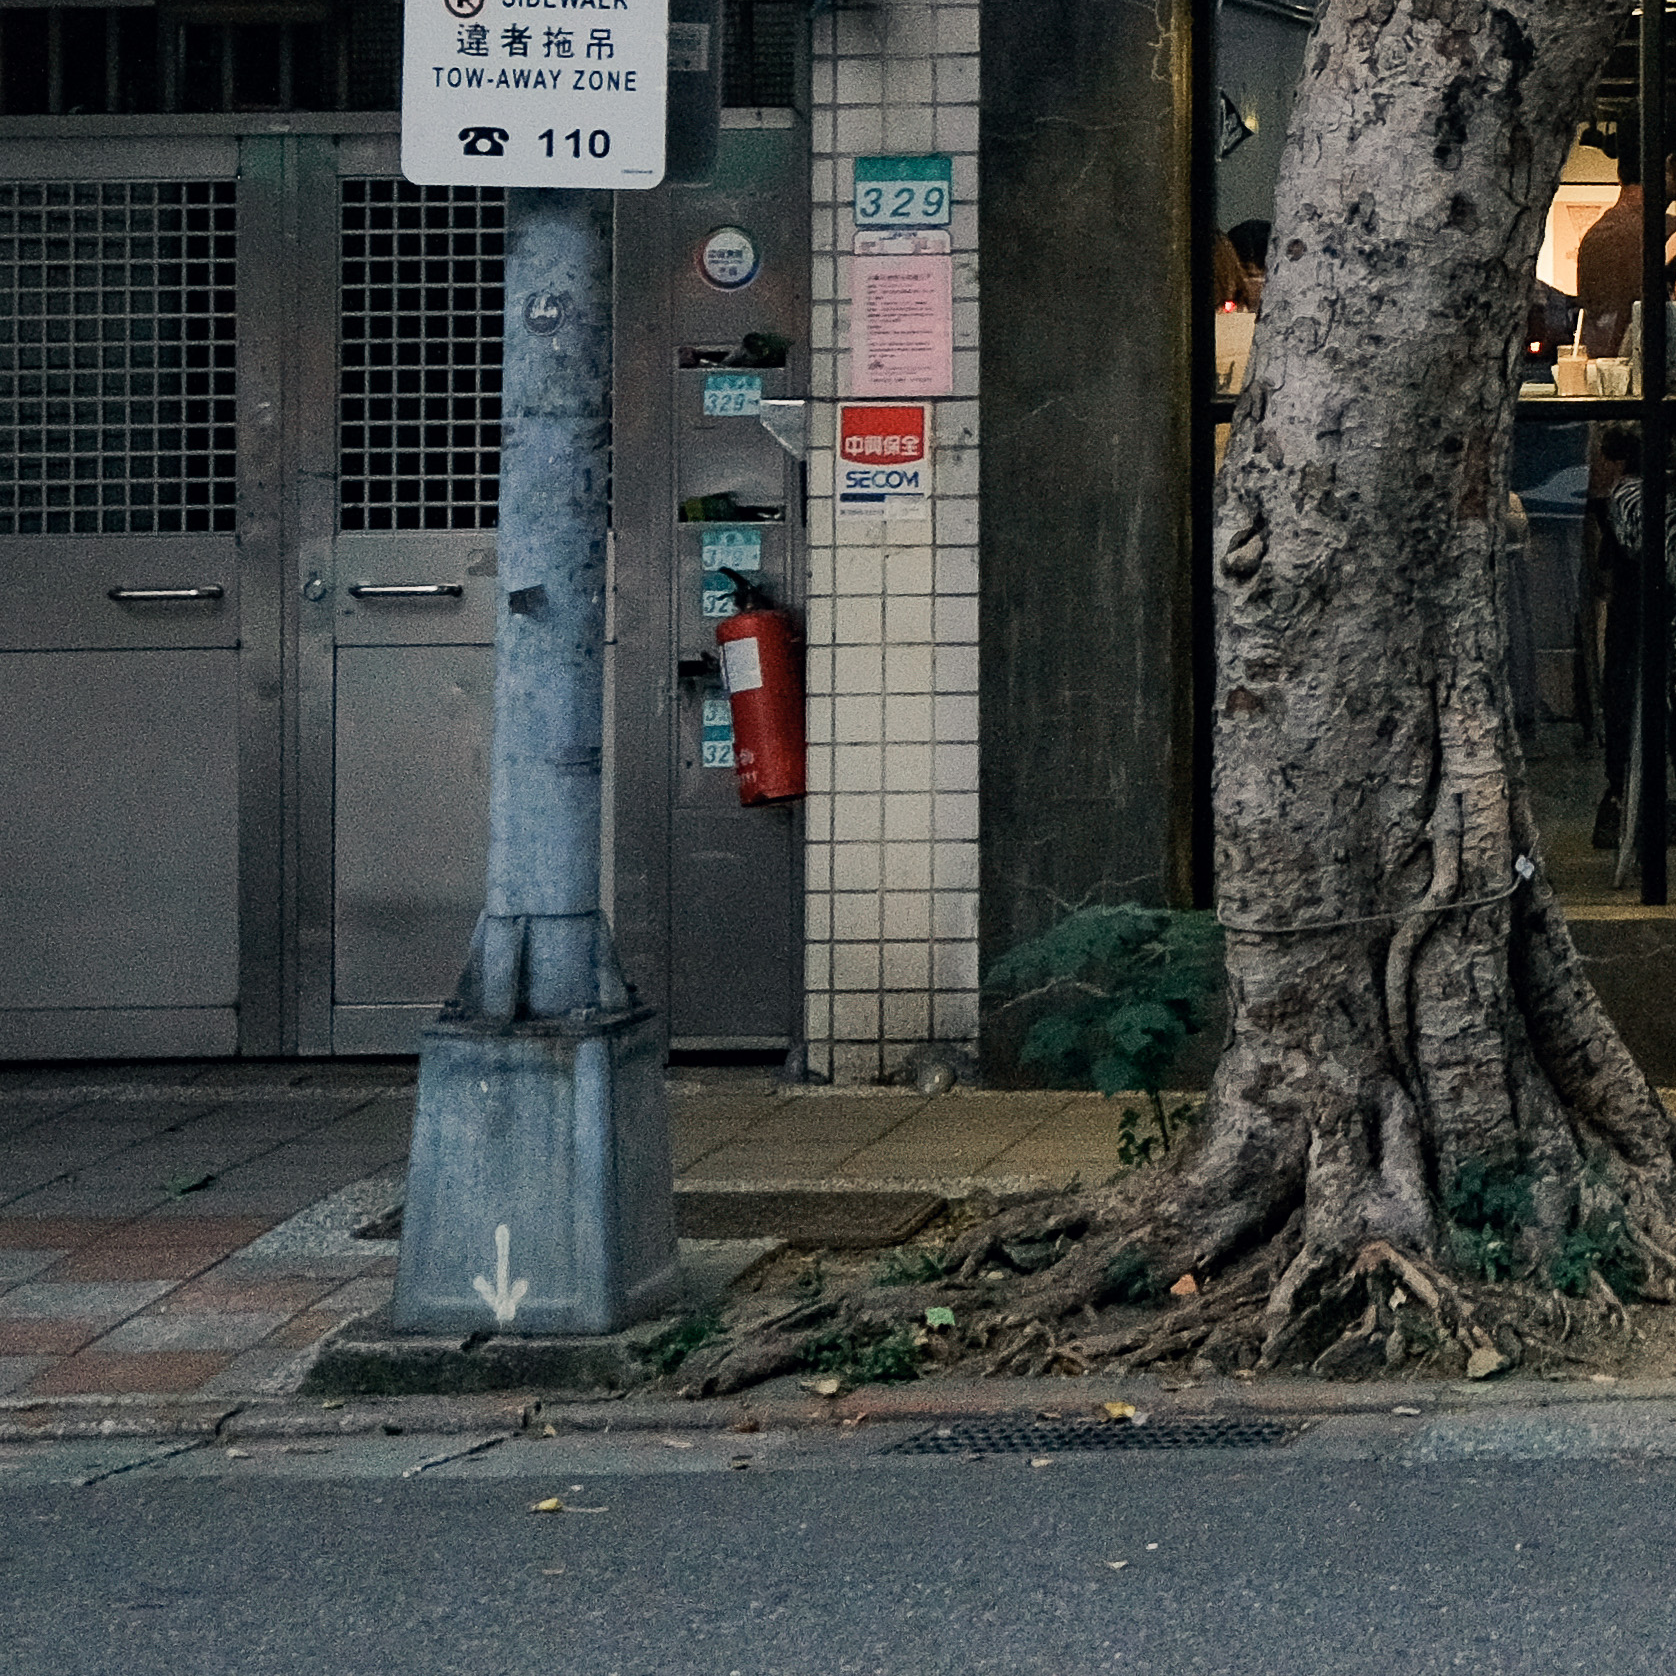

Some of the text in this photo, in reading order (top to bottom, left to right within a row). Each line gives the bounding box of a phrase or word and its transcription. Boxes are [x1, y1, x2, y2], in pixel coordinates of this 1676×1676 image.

[456, 24, 615, 61] 違者拖吊
[432, 67, 638, 93] TOW-AWAY ZONE
[538, 128, 612, 158] 110
[860, 187, 945, 218] 329
[846, 470, 919, 489] SECOM
